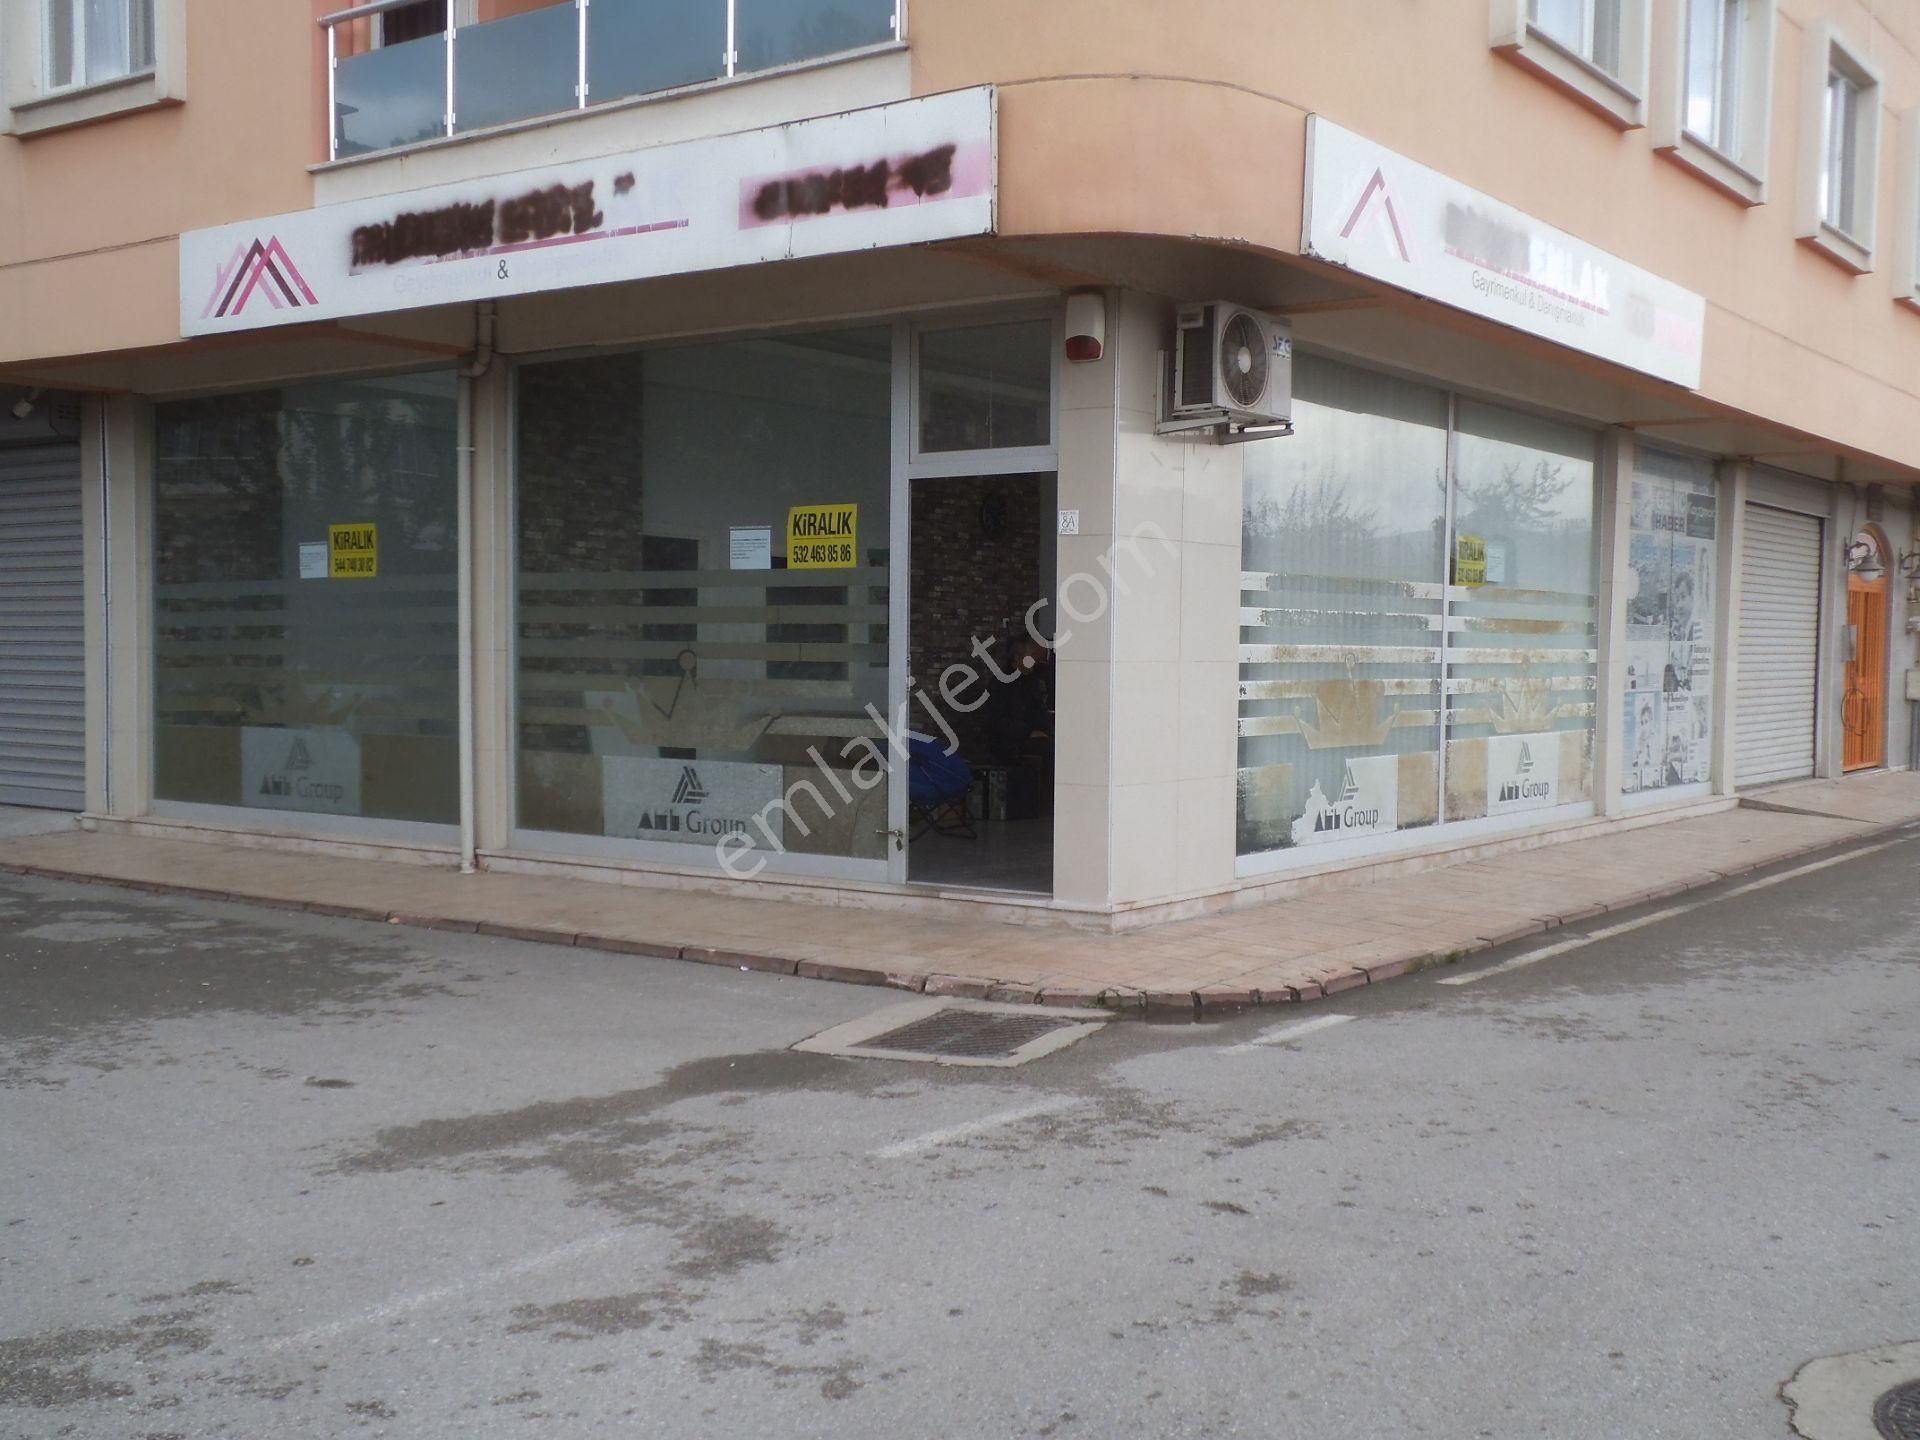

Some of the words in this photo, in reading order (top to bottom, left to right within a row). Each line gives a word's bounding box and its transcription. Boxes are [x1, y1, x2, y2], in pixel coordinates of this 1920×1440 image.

[496, 258, 509, 280] &
[1528, 292, 1536, 308] &
[1655, 512, 1686, 533] HABER
[793, 546, 809, 563] 532
[811, 544, 826, 562] 463
[828, 544, 838, 562] 85
[840, 544, 852, 562] 86
[1521, 778, 1550, 801] Group
[1344, 806, 1379, 829] Group
